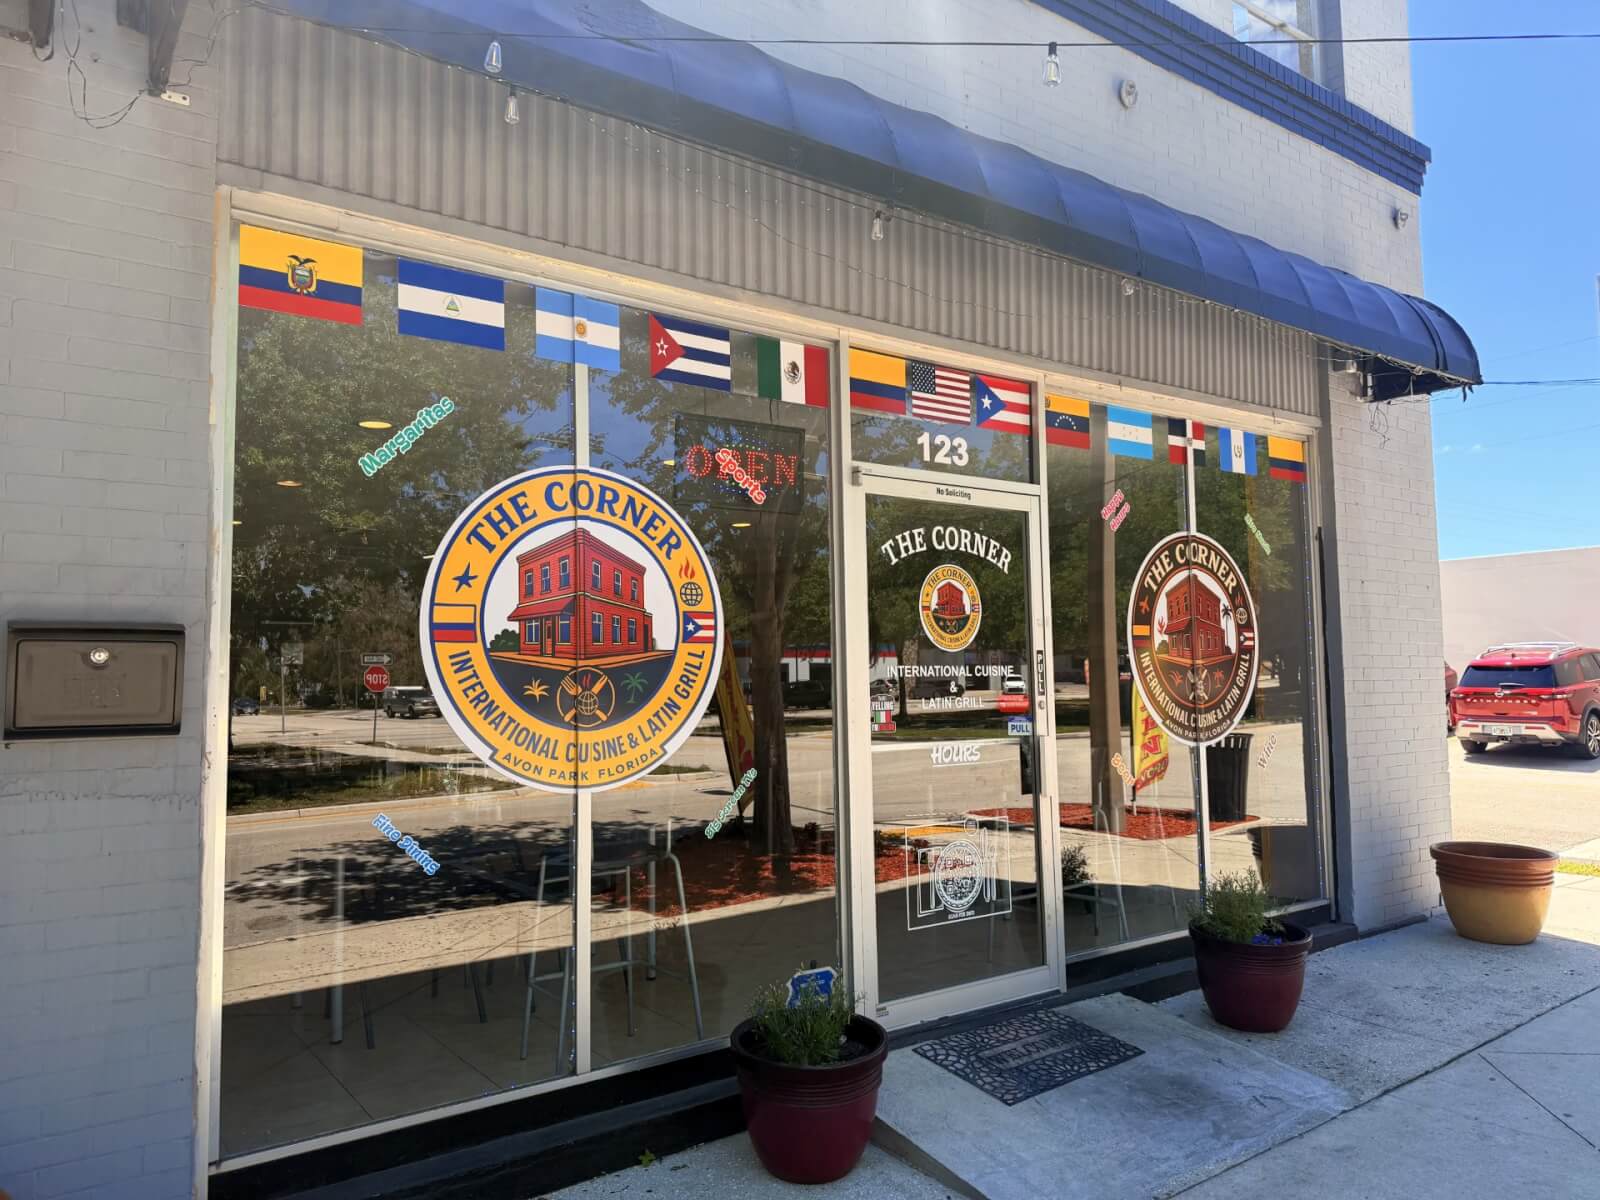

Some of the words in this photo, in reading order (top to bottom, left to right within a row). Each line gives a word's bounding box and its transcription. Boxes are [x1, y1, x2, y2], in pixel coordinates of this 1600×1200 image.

[358, 396, 455, 477] Margaritas
[917, 431, 969, 467] 123
[715, 448, 766, 505] Sports
[936, 486, 944, 496] No
[467, 491, 537, 554] THE
[544, 480, 682, 560] CORNER
[881, 527, 927, 566] THE
[931, 525, 1012, 574] CORNER
[928, 573, 942, 588] THE
[942, 568, 972, 588] CORNER
[1144, 550, 1174, 593] THE
[1175, 543, 1237, 594] CORNER
[887, 665, 972, 677] INTERNATIONAL
[974, 665, 1014, 677] CUISINE
[950, 681, 958, 693] &
[1037, 654, 1045, 692] PULL
[449, 650, 559, 761] INTERNATIONAL
[565, 736, 627, 763] CUSINE
[627, 733, 640, 749] &
[638, 697, 681, 743] LATIN
[674, 650, 705, 700] GRILL
[921, 697, 952, 710] LATIN
[954, 696, 984, 709] GRILL
[1140, 652, 1189, 726] INTERNATIONAL
[1191, 710, 1218, 727] CUSINE
[1220, 685, 1241, 715] LATIN
[1236, 653, 1250, 688] GRILL
[1010, 724, 1030, 733] PULL
[1165, 719, 1183, 736] AVON
[1205, 719, 1231, 737] FLORIDA
[503, 752, 543, 775] AVON
[548, 768, 589, 781] PARK
[598, 748, 658, 779] FLORIDA
[931, 744, 981, 765] HOURS
[372, 812, 401, 842] Fine
[397, 835, 440, 876] Dining
